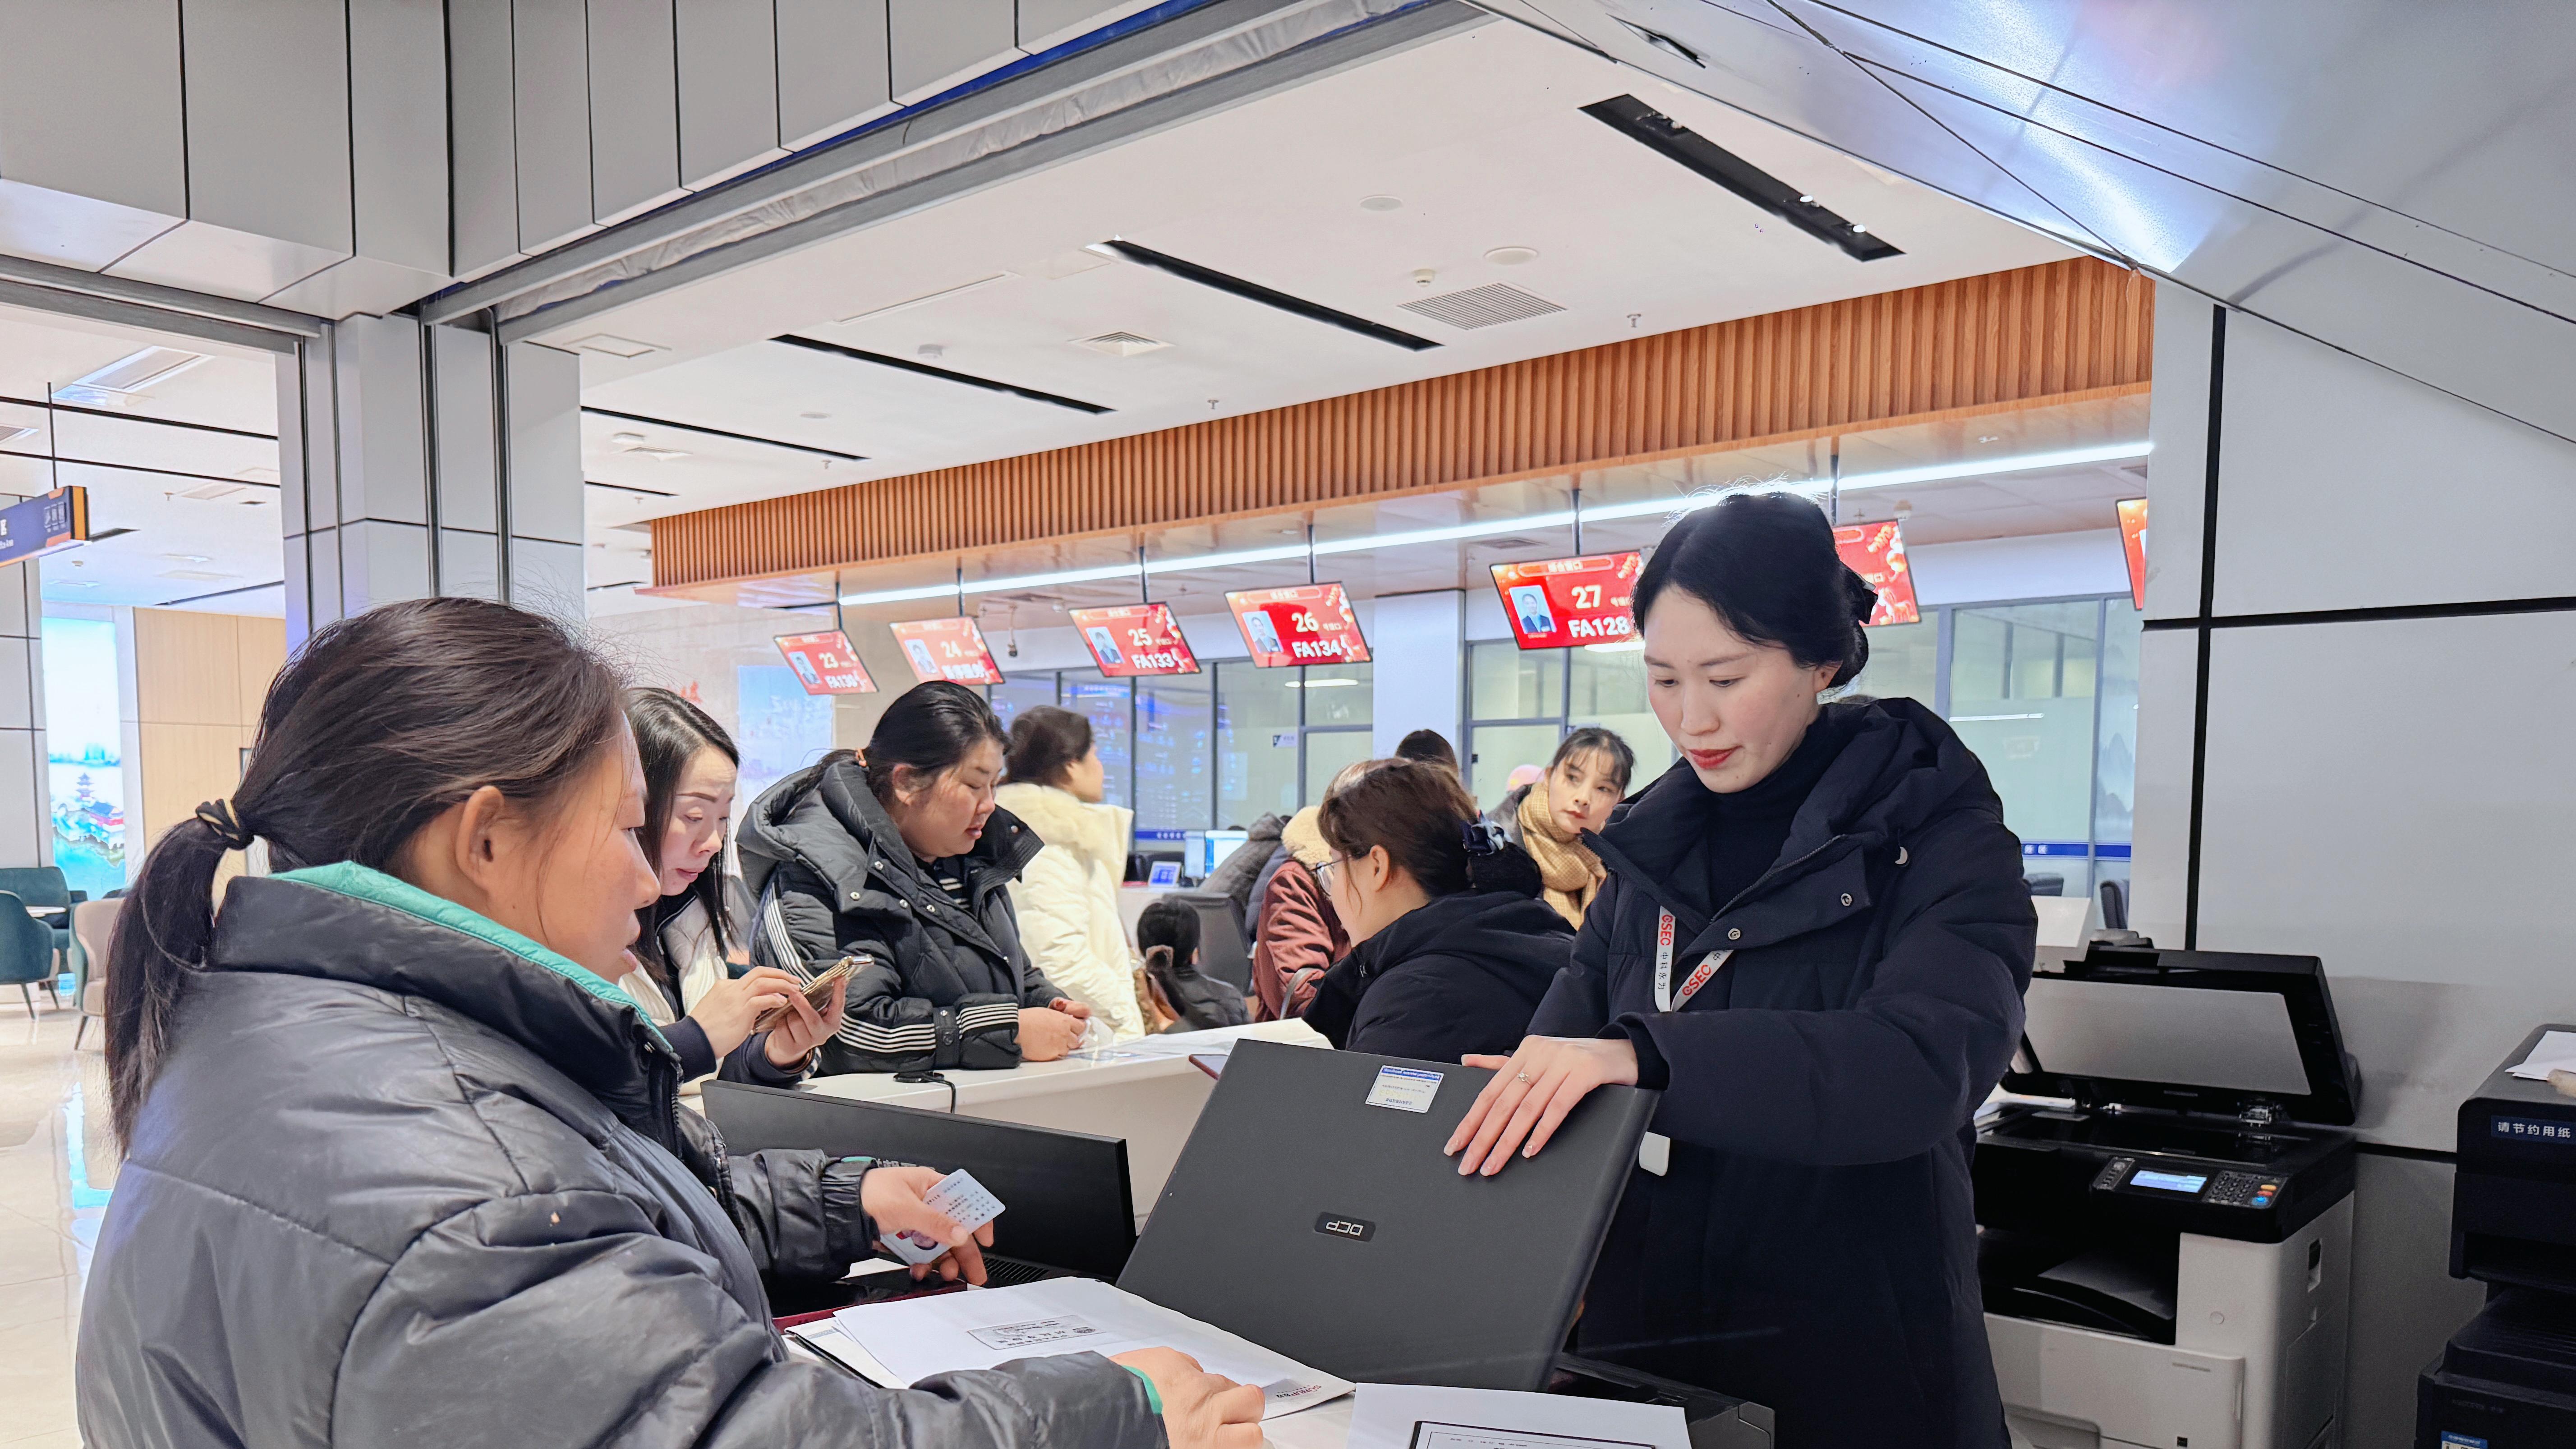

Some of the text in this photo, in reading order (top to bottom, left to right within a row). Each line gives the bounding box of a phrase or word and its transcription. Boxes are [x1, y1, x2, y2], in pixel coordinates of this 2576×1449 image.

[1572, 584, 1601, 608] 27
[1291, 612, 1319, 632] 26
[1568, 616, 1630, 638] FA128
[1127, 628, 1152, 646] 25
[940, 641, 962, 657] 24
[1292, 639, 1342, 658] FA134
[818, 652, 839, 668] 23
[1131, 653, 1175, 669] FA133
[2498, 1122, 2571, 1138] 请节约用纸
[1325, 1220, 1364, 1236] DCP
